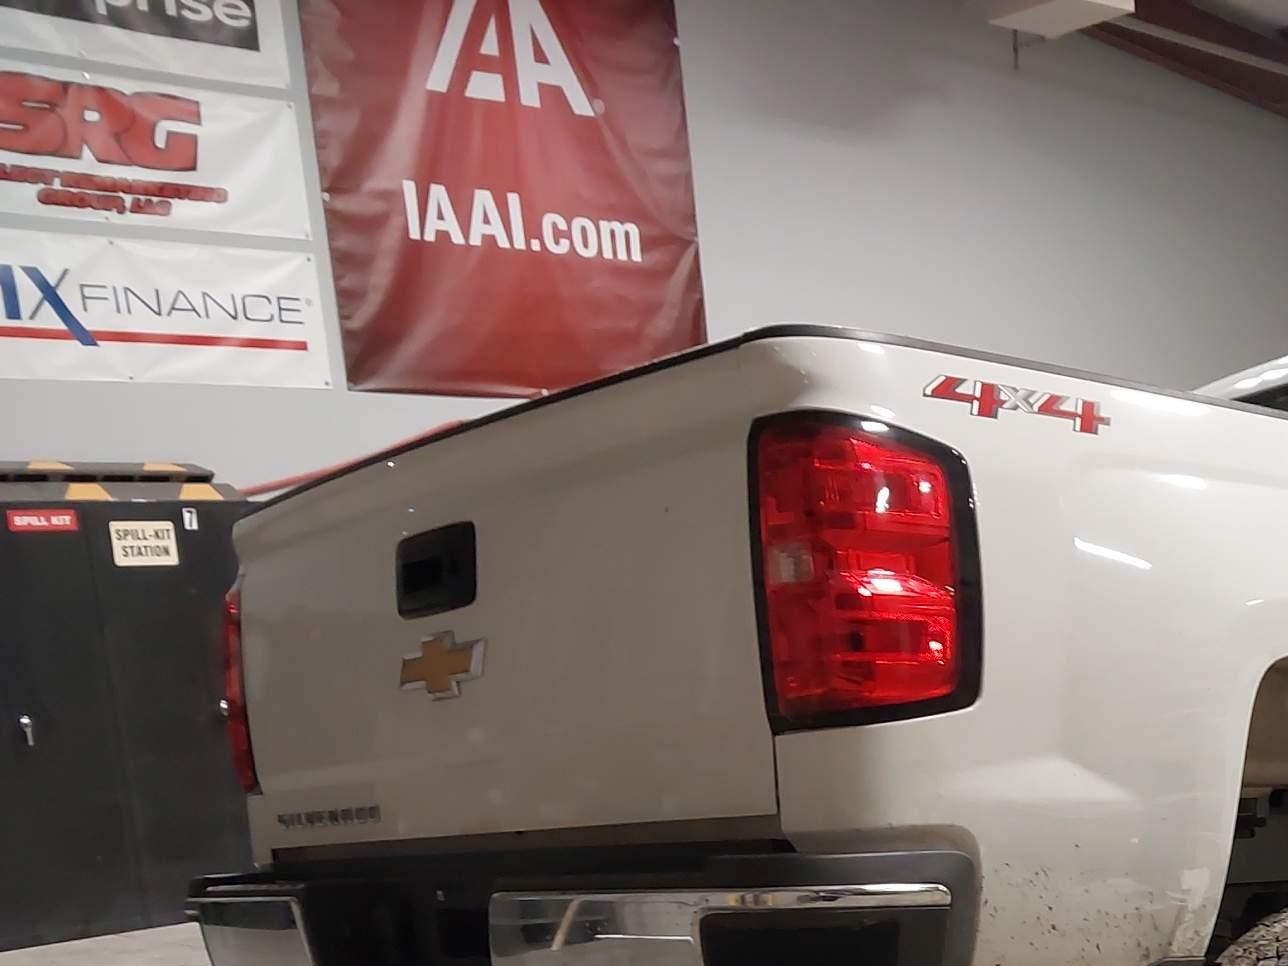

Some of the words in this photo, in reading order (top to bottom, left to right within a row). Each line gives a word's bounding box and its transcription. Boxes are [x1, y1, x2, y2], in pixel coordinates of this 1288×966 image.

[0, 71, 201, 172] SRG
[402, 179, 642, 262] IAAI.com
[79, 283, 305, 325] FINANCE
[13, 515, 48, 526] SPILL
[50, 515, 72, 526] KIT
[114, 528, 171, 541] SPILL-KIT
[120, 545, 170, 558] STATION
